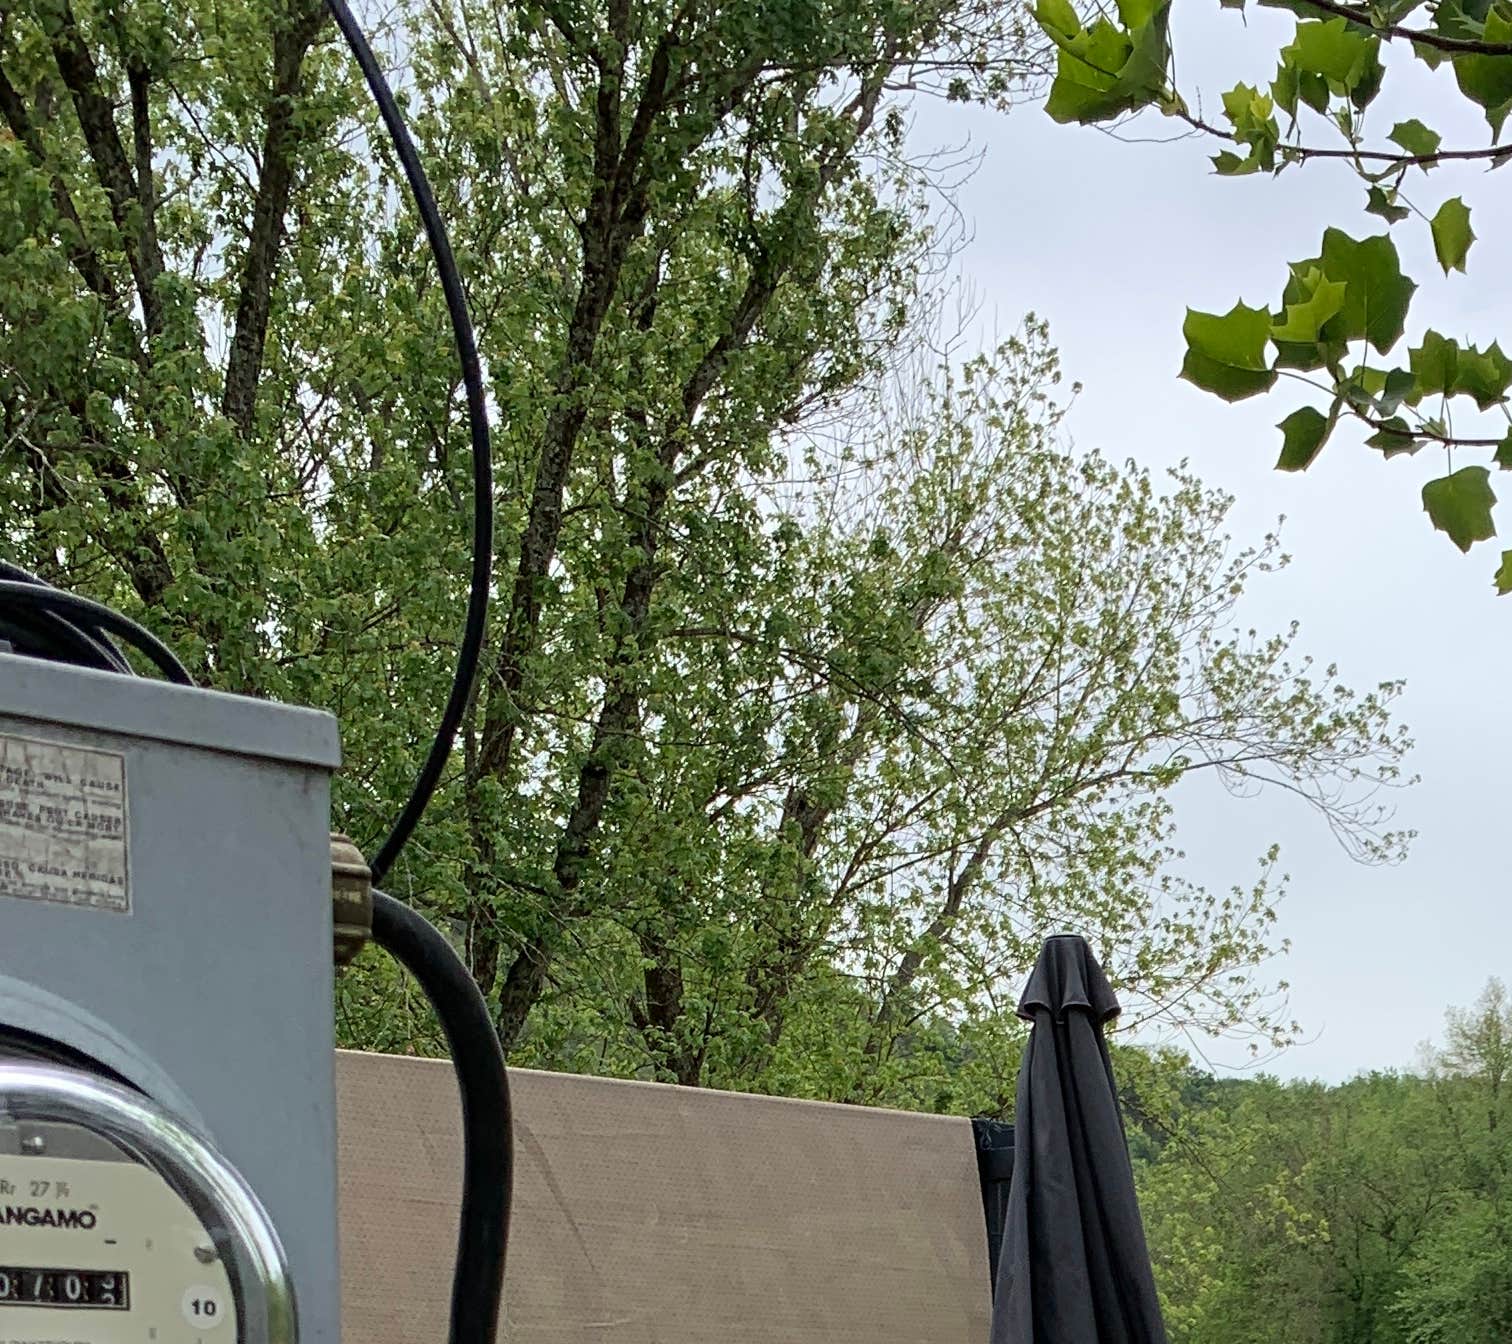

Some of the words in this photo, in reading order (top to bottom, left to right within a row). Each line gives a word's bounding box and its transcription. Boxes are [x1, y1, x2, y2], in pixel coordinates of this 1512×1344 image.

[80, 778, 119, 790] CAUSE
[30, 1180, 50, 1197] 27
[191, 1300, 217, 1316] 10
